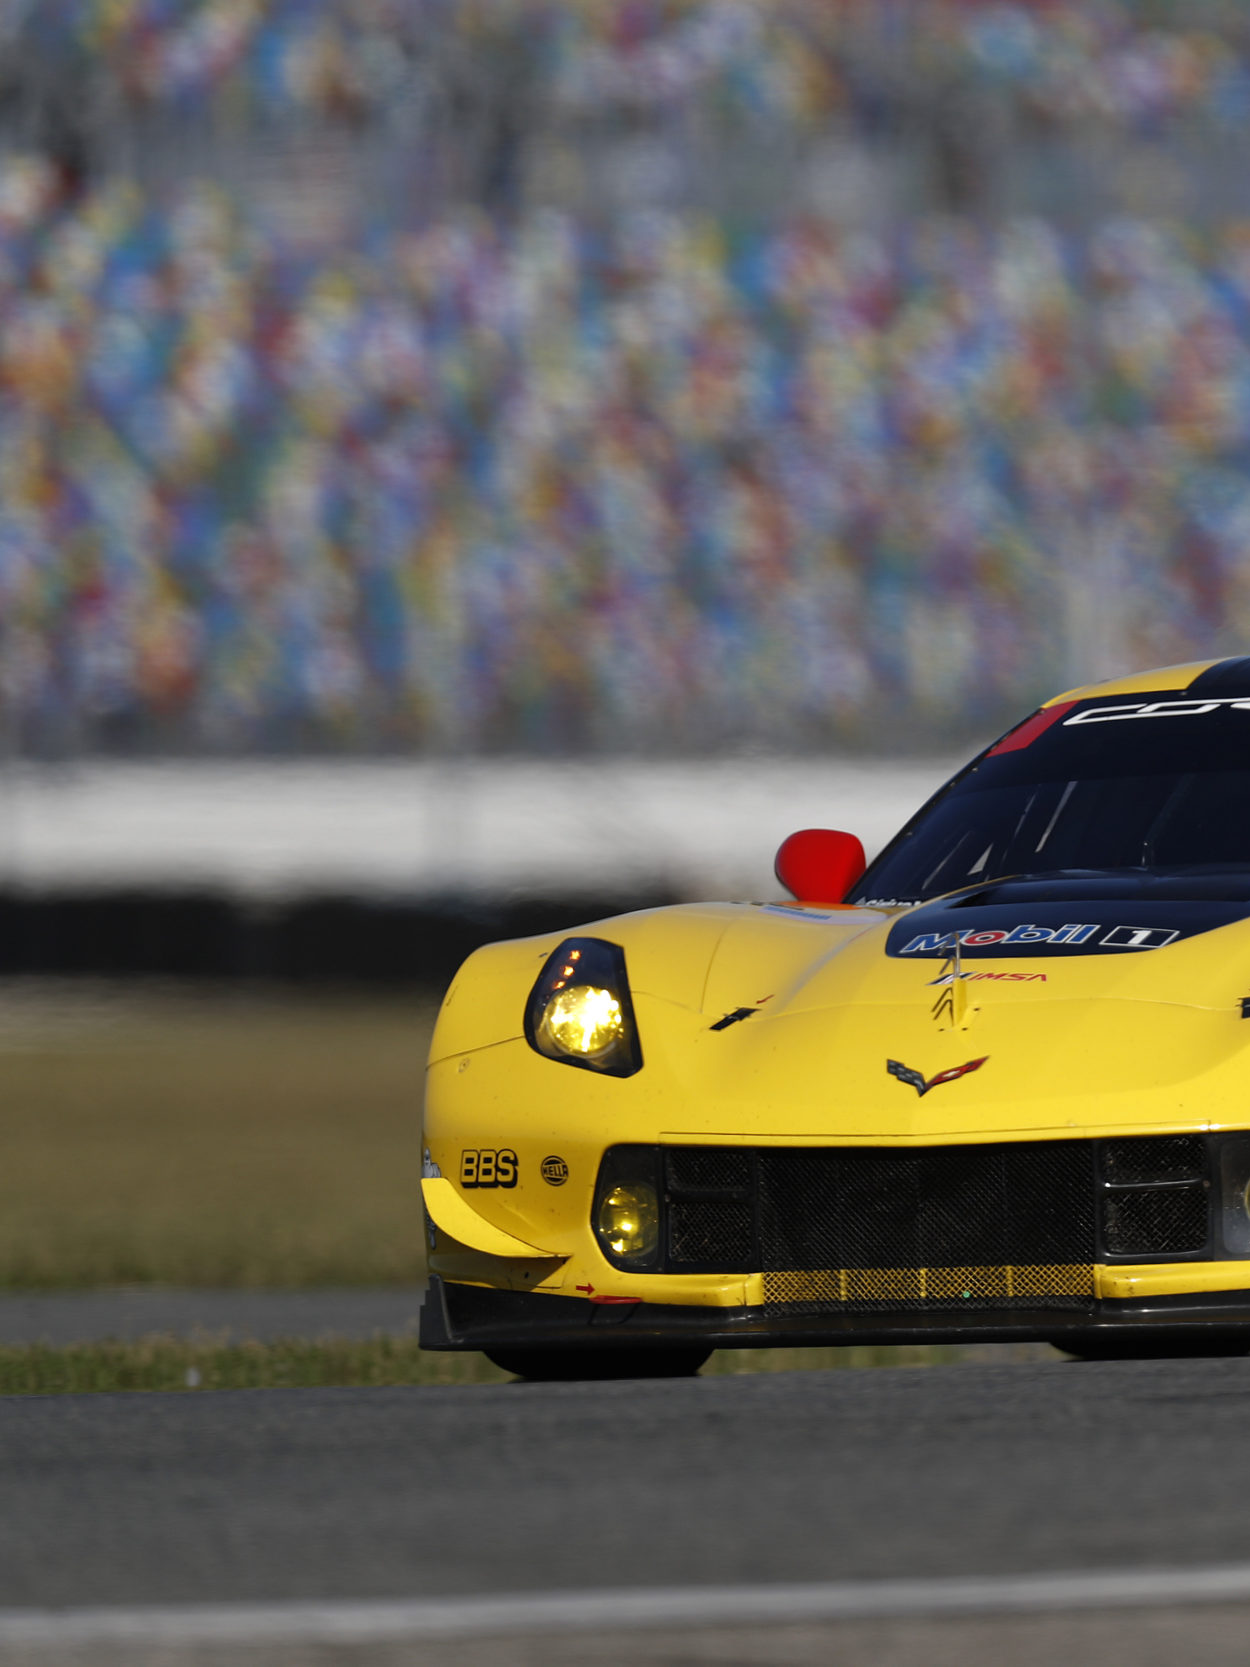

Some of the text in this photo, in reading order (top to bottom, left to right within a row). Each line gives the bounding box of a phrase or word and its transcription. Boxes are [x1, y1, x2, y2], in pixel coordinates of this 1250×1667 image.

[899, 924, 1101, 953] Mobil
[968, 972, 1047, 982] IMSA
[460, 1148, 519, 1189] BBS
